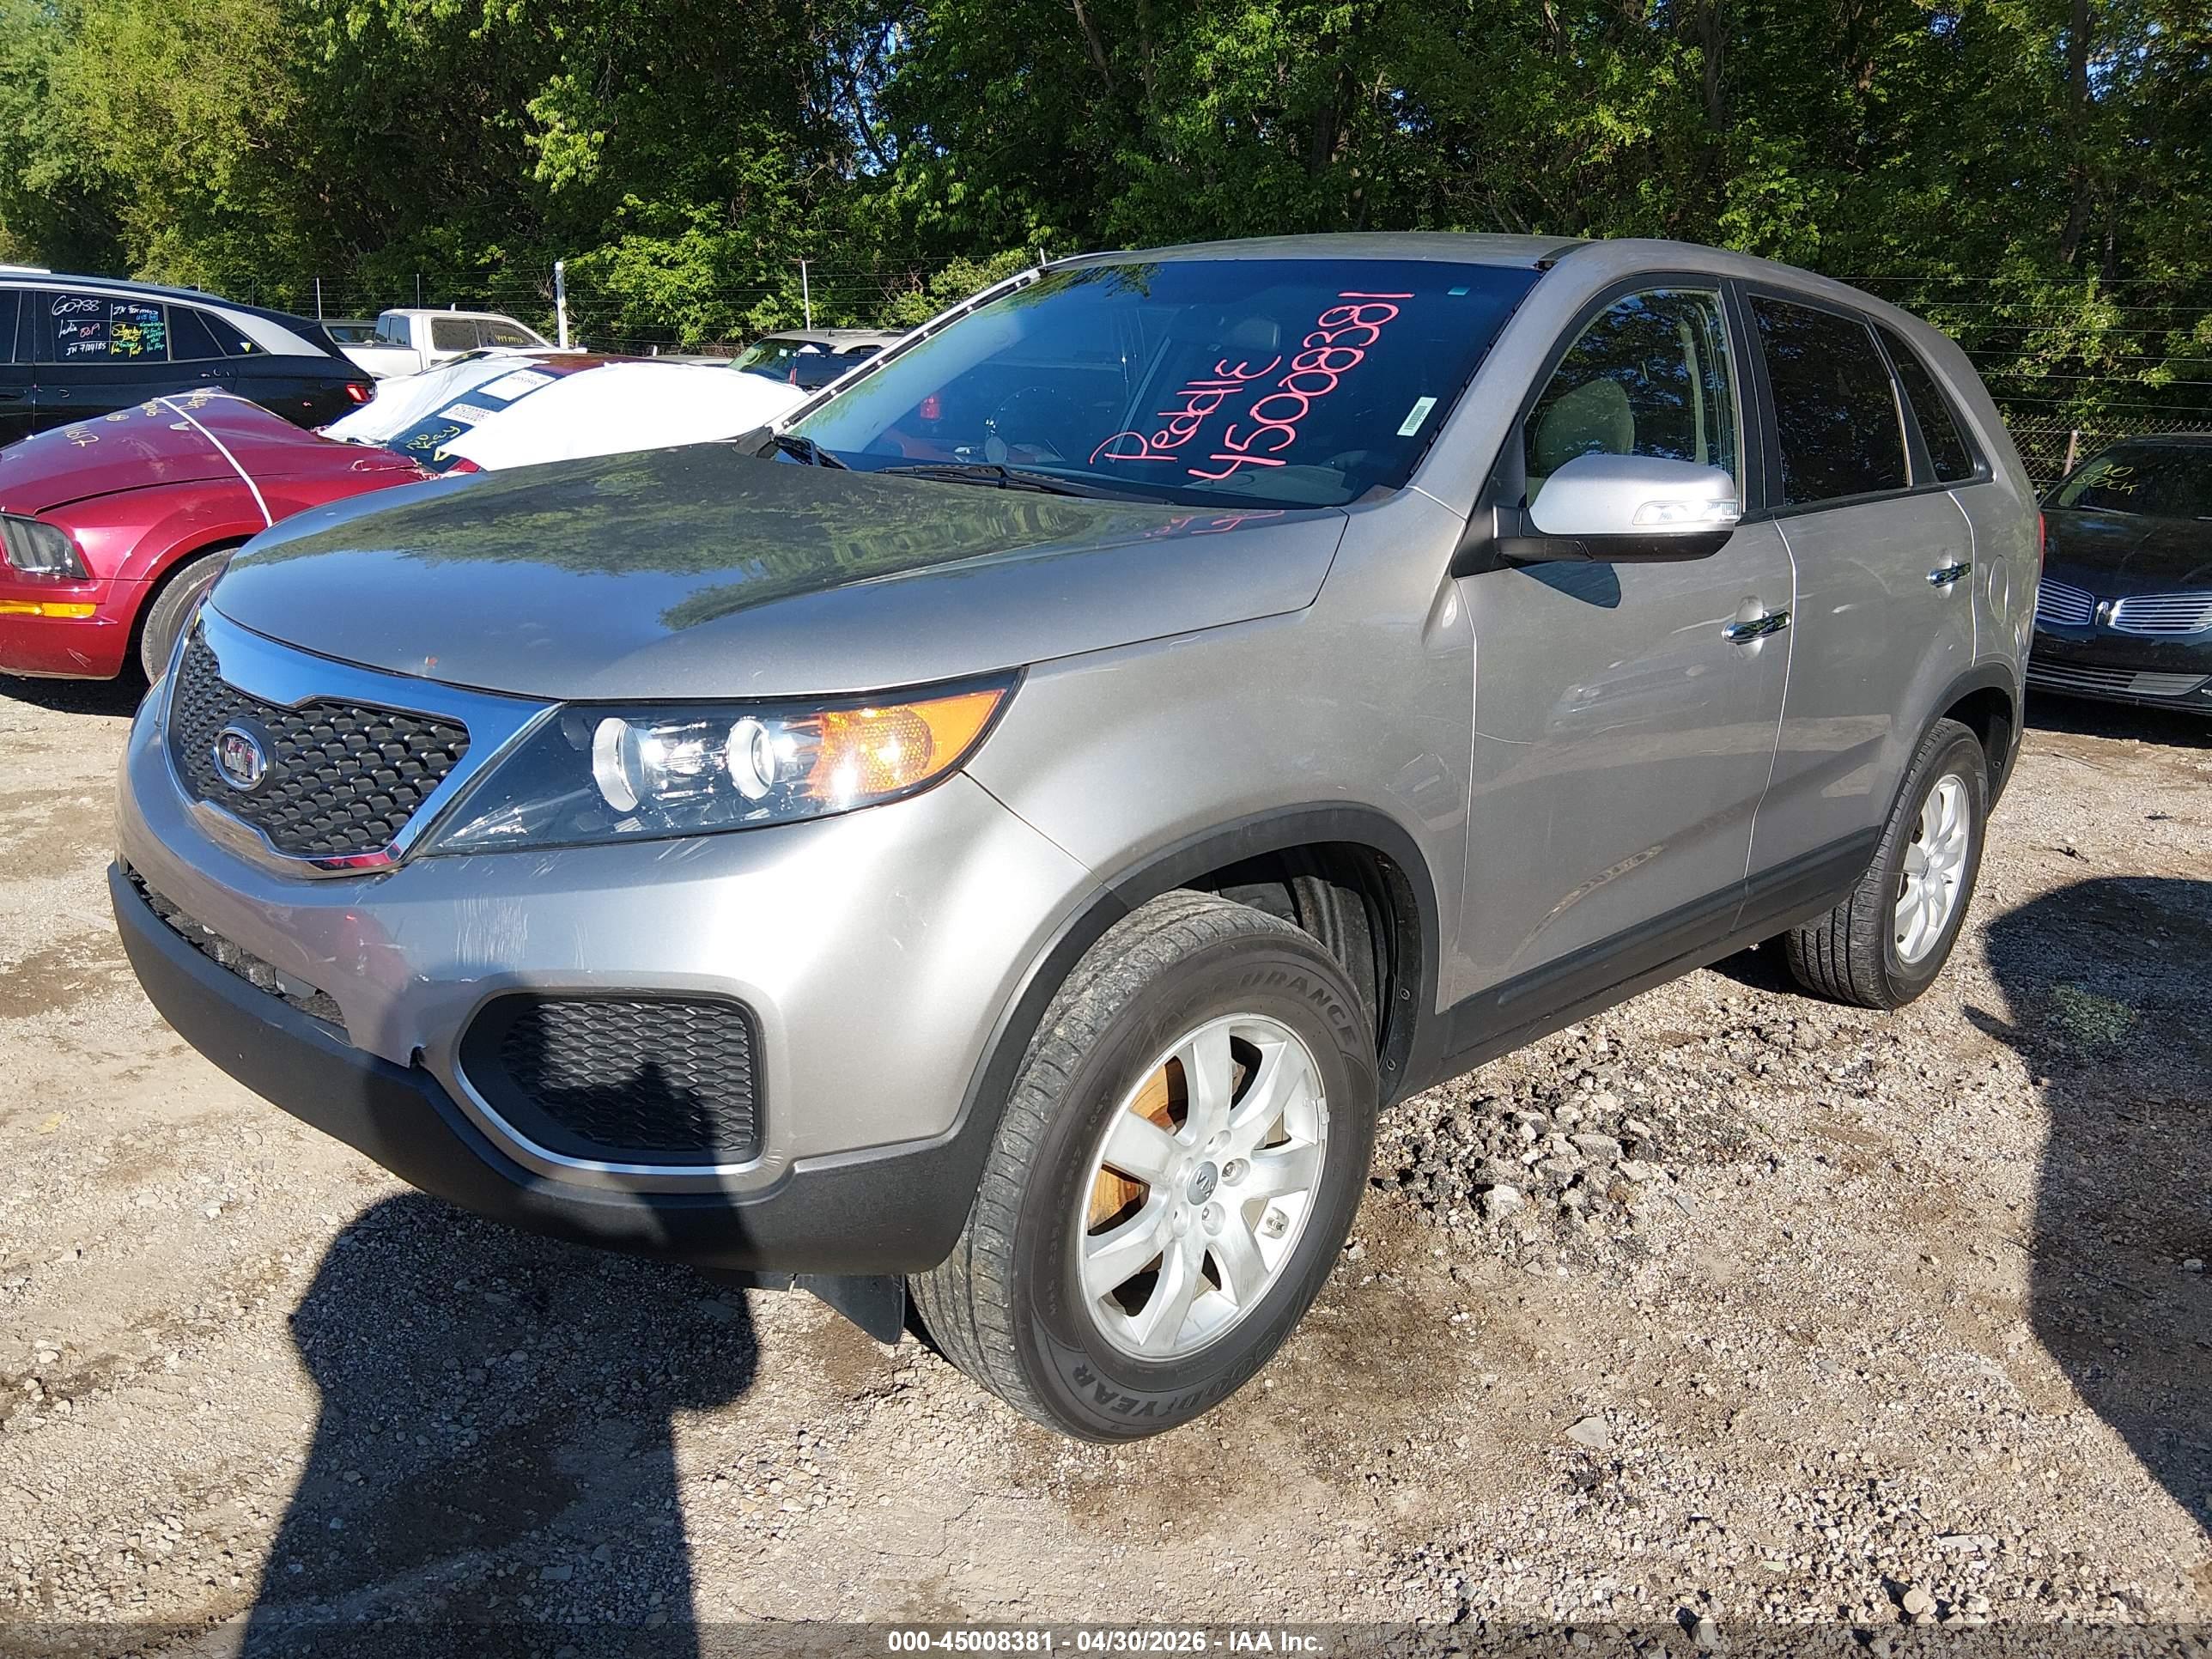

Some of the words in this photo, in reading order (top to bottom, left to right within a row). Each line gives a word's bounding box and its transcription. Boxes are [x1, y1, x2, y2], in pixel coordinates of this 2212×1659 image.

[1188, 291, 1416, 481] 45008381
[2094, 464, 2135, 477] NO
[2071, 473, 2141, 495] STOCK
